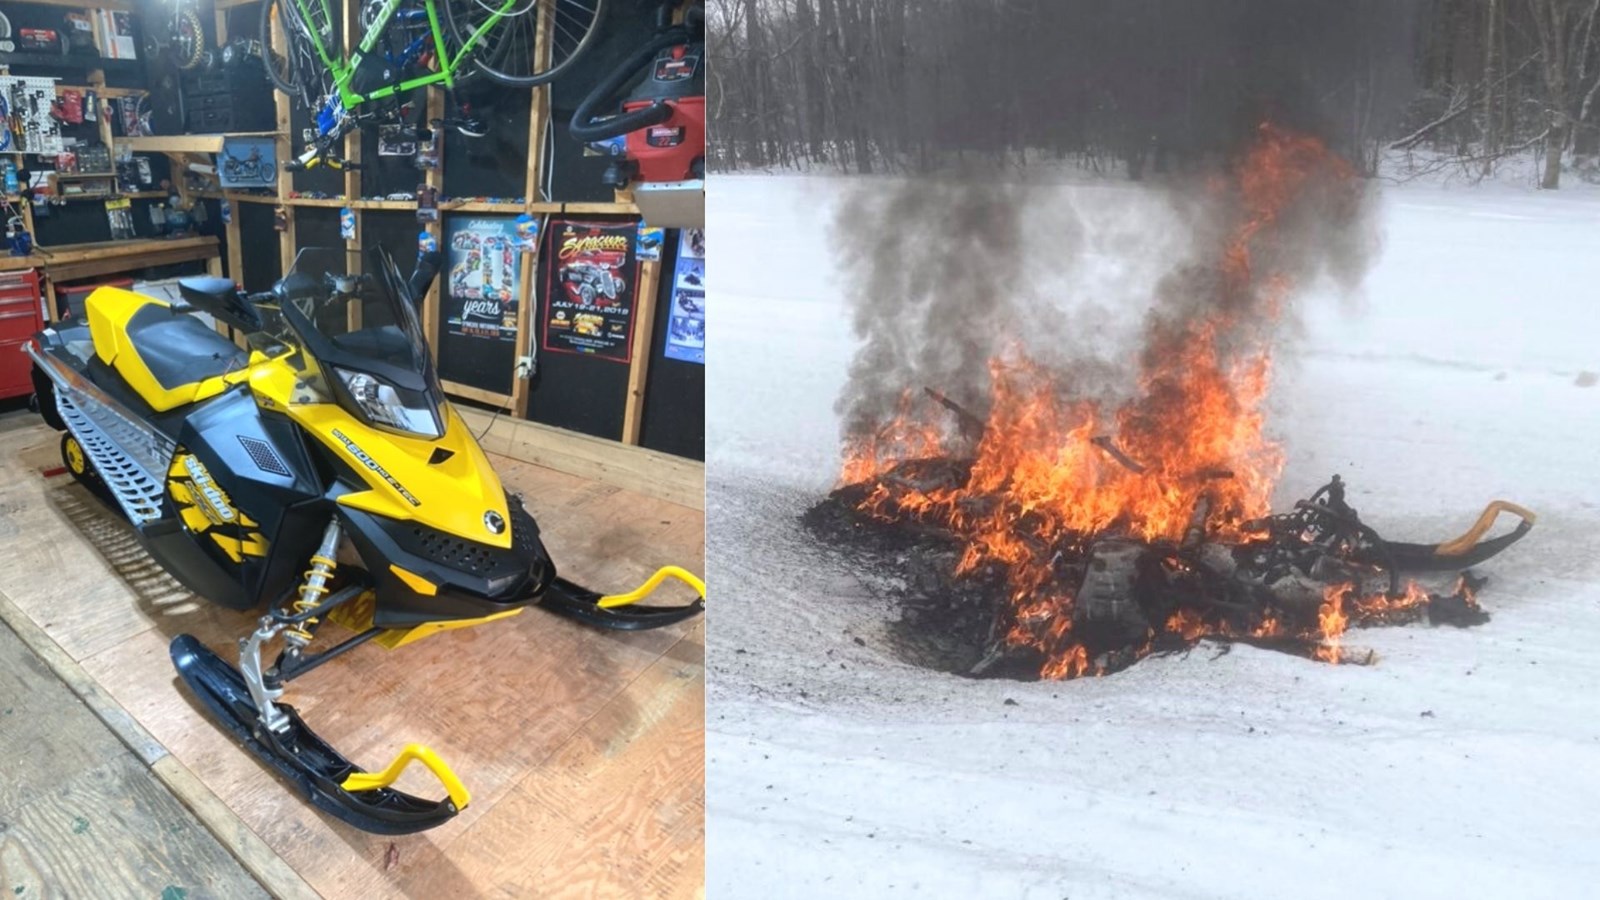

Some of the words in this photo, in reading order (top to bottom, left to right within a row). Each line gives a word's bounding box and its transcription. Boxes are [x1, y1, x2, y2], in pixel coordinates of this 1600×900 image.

[463, 300, 501, 321] years
[552, 301, 573, 309] JULY
[346, 443, 379, 471] 600
[184, 456, 234, 519] ski-doo
